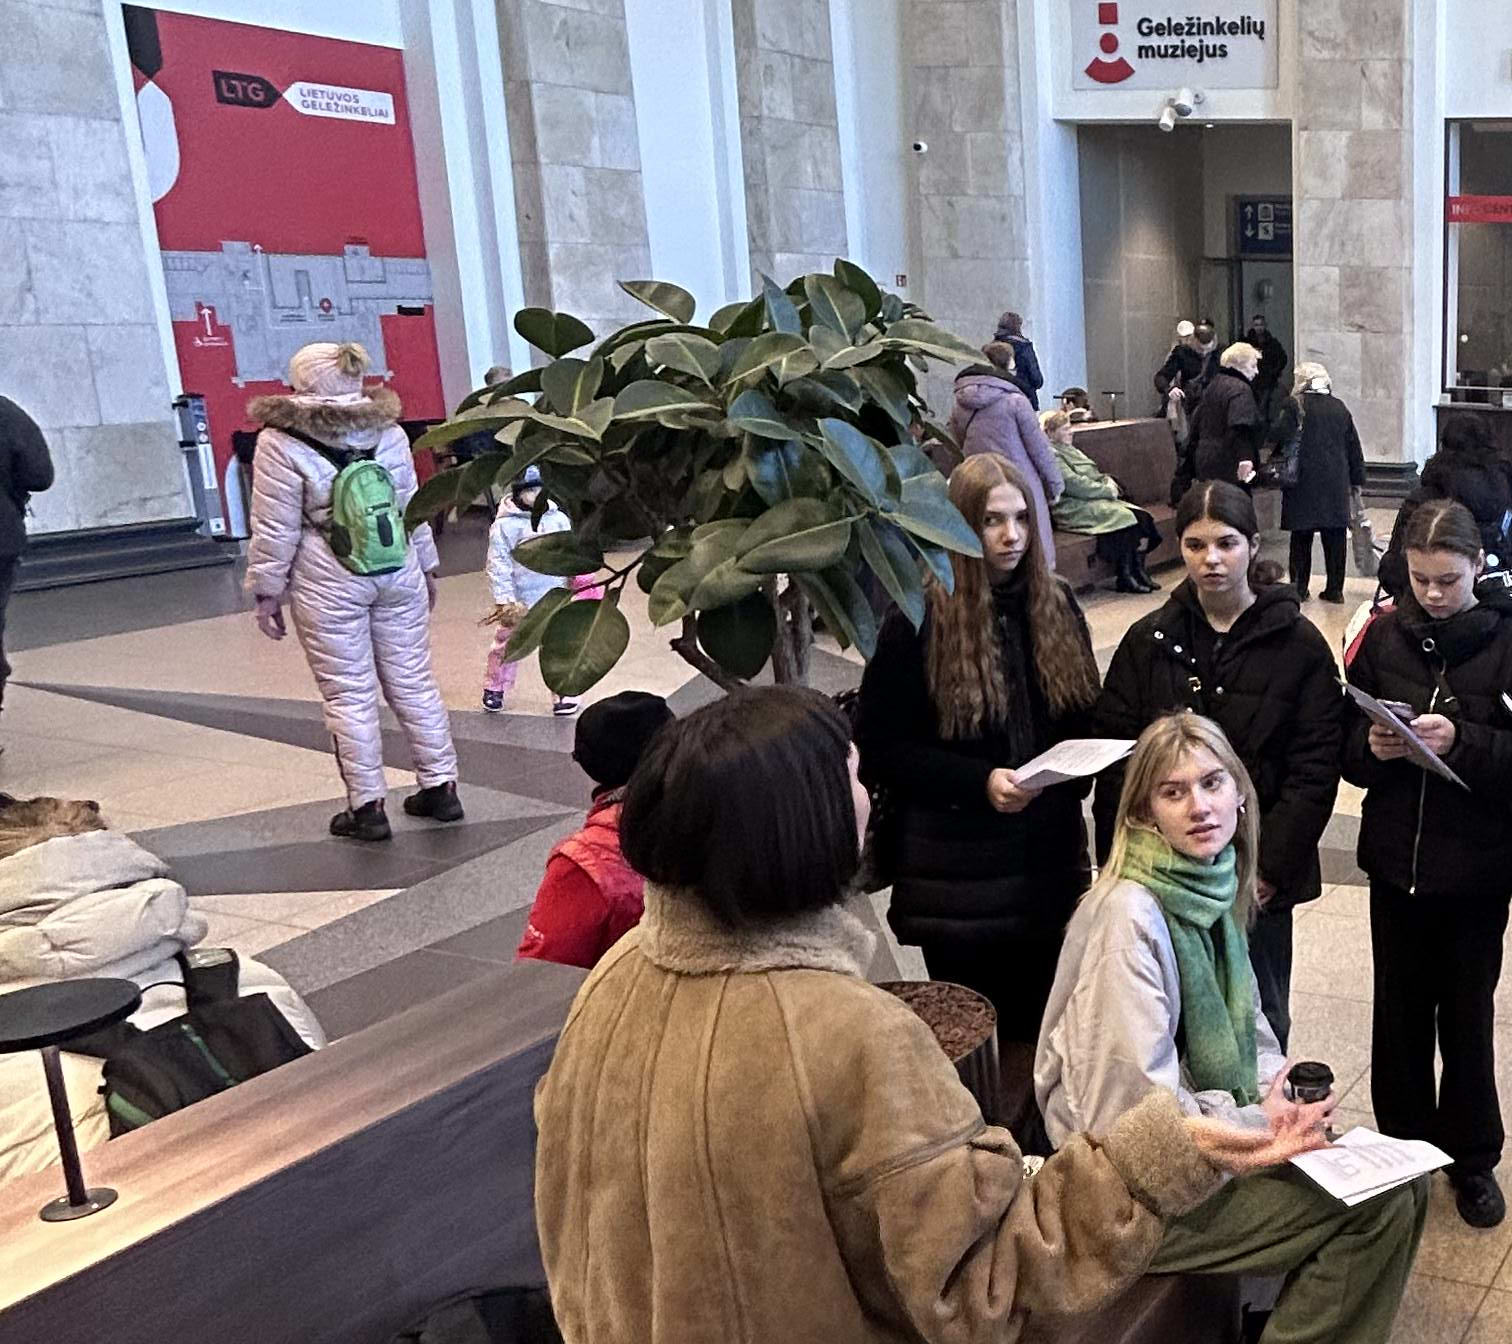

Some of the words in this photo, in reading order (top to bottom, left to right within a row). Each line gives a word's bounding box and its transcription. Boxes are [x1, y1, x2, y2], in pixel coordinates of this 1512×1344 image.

[1137, 15, 1265, 40] Geležinkelių
[1137, 38, 1228, 63] muziejus
[219, 78, 266, 102] LTG
[299, 87, 360, 104] LIETUVOS
